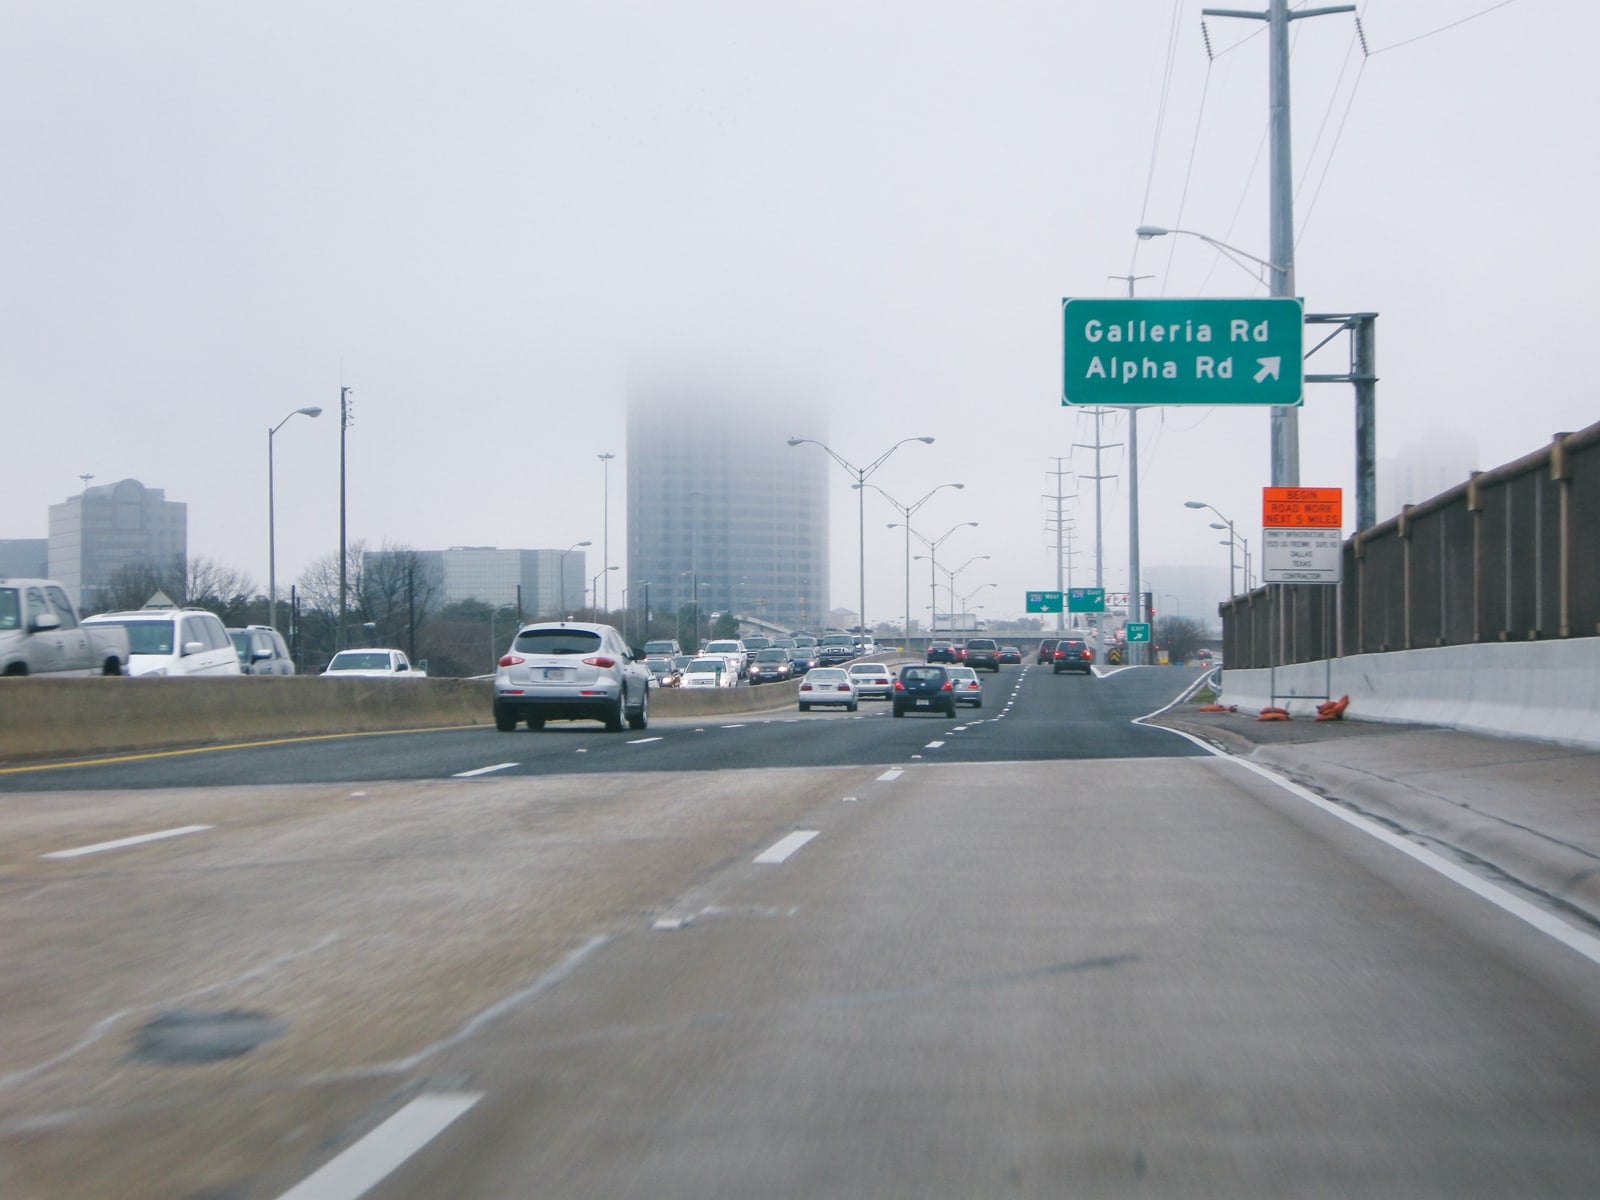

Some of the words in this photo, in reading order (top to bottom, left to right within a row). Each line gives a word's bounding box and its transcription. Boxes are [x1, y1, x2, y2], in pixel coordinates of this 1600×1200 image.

[1084, 319, 1212, 342] Galleria
[1230, 319, 1269, 342] Rd
[1085, 356, 1178, 384] Alpha
[1196, 356, 1233, 378] Rd
[1287, 490, 1318, 499] BEGIN
[1271, 503, 1299, 513] ROAD
[1304, 503, 1333, 513] WORK
[1266, 514, 1292, 523] NEXT
[1296, 515, 1302, 524] 5
[1308, 514, 1338, 523] MILES
